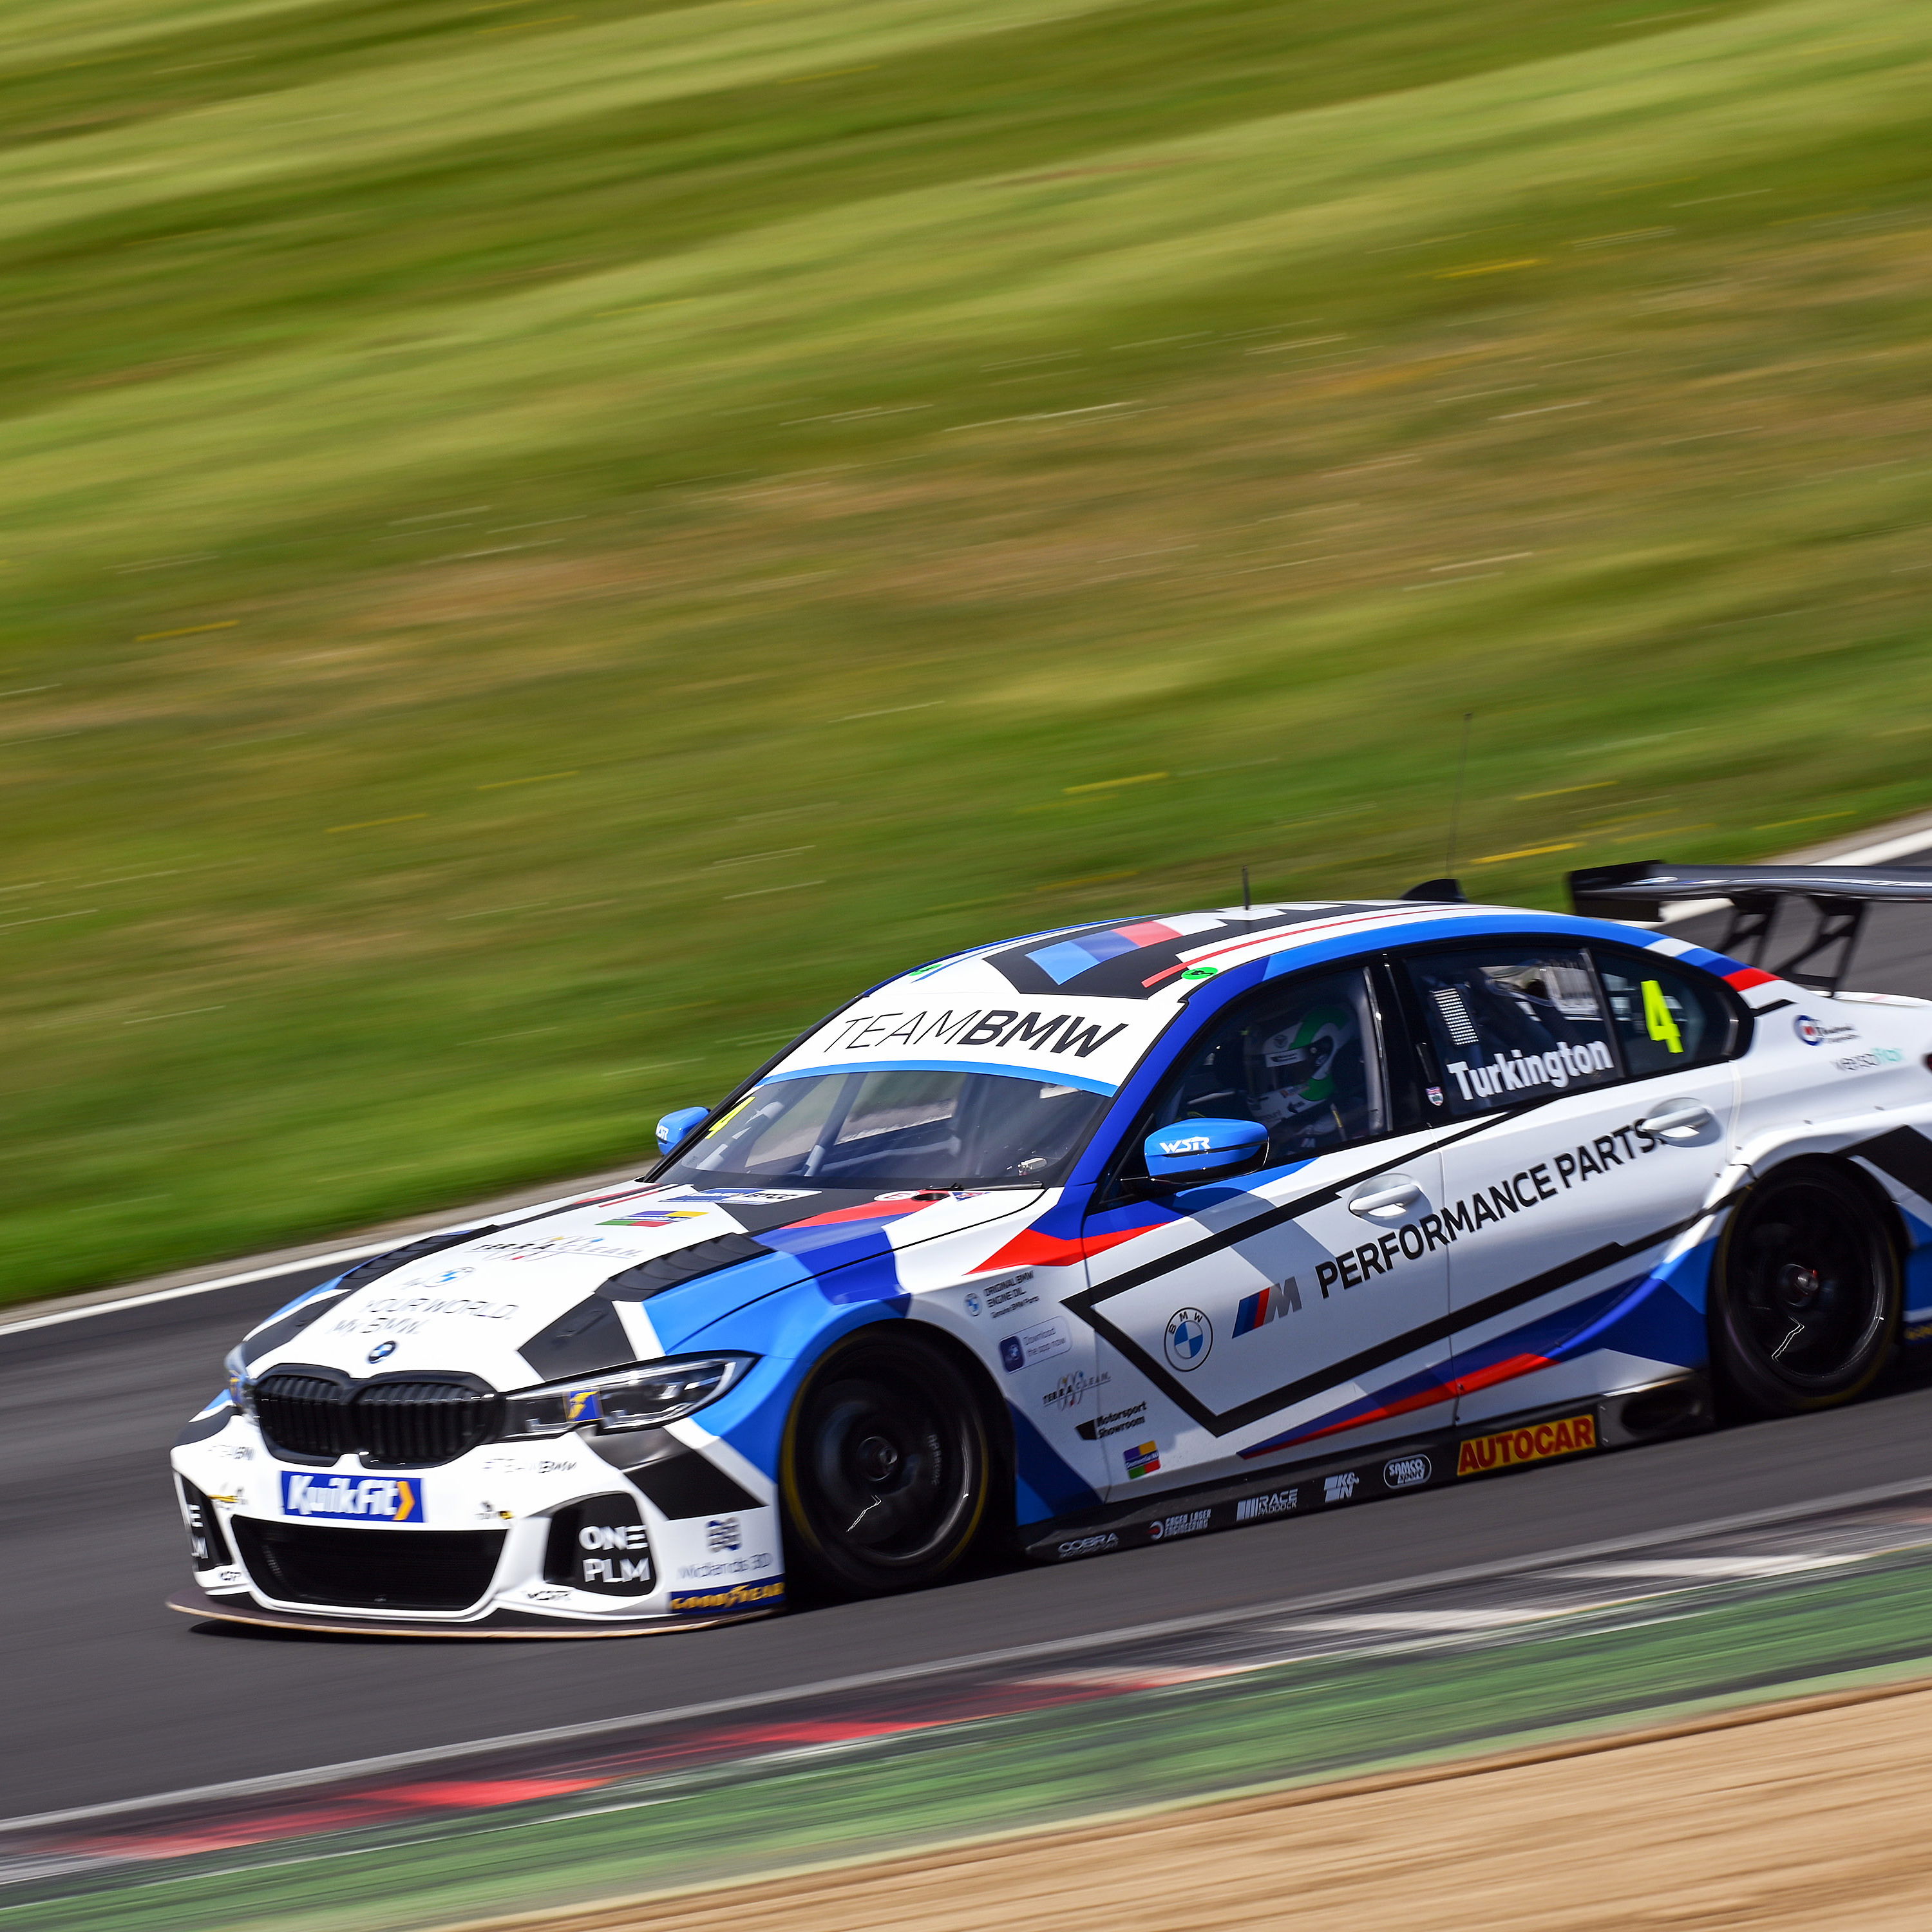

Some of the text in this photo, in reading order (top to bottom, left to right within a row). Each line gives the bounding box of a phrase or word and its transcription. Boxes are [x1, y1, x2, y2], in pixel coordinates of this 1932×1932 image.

[1641, 980, 1683, 1053] 4
[1447, 1041, 1615, 1100] Turkington
[1160, 1136, 1211, 1153] WSR
[1315, 1164, 1558, 1298] PERFORMANCE
[1097, 1401, 1147, 1427] Motorsport
[1098, 1416, 1145, 1439] Showroom
[1458, 1417, 1594, 1473] AUTOCAR
[1389, 1457, 1424, 1477] SAMCO
[1258, 1488, 1298, 1509] RACE
[579, 1525, 648, 1550] ONE
[1057, 1533, 1119, 1553] COBRA
[582, 1557, 650, 1582] PLM
